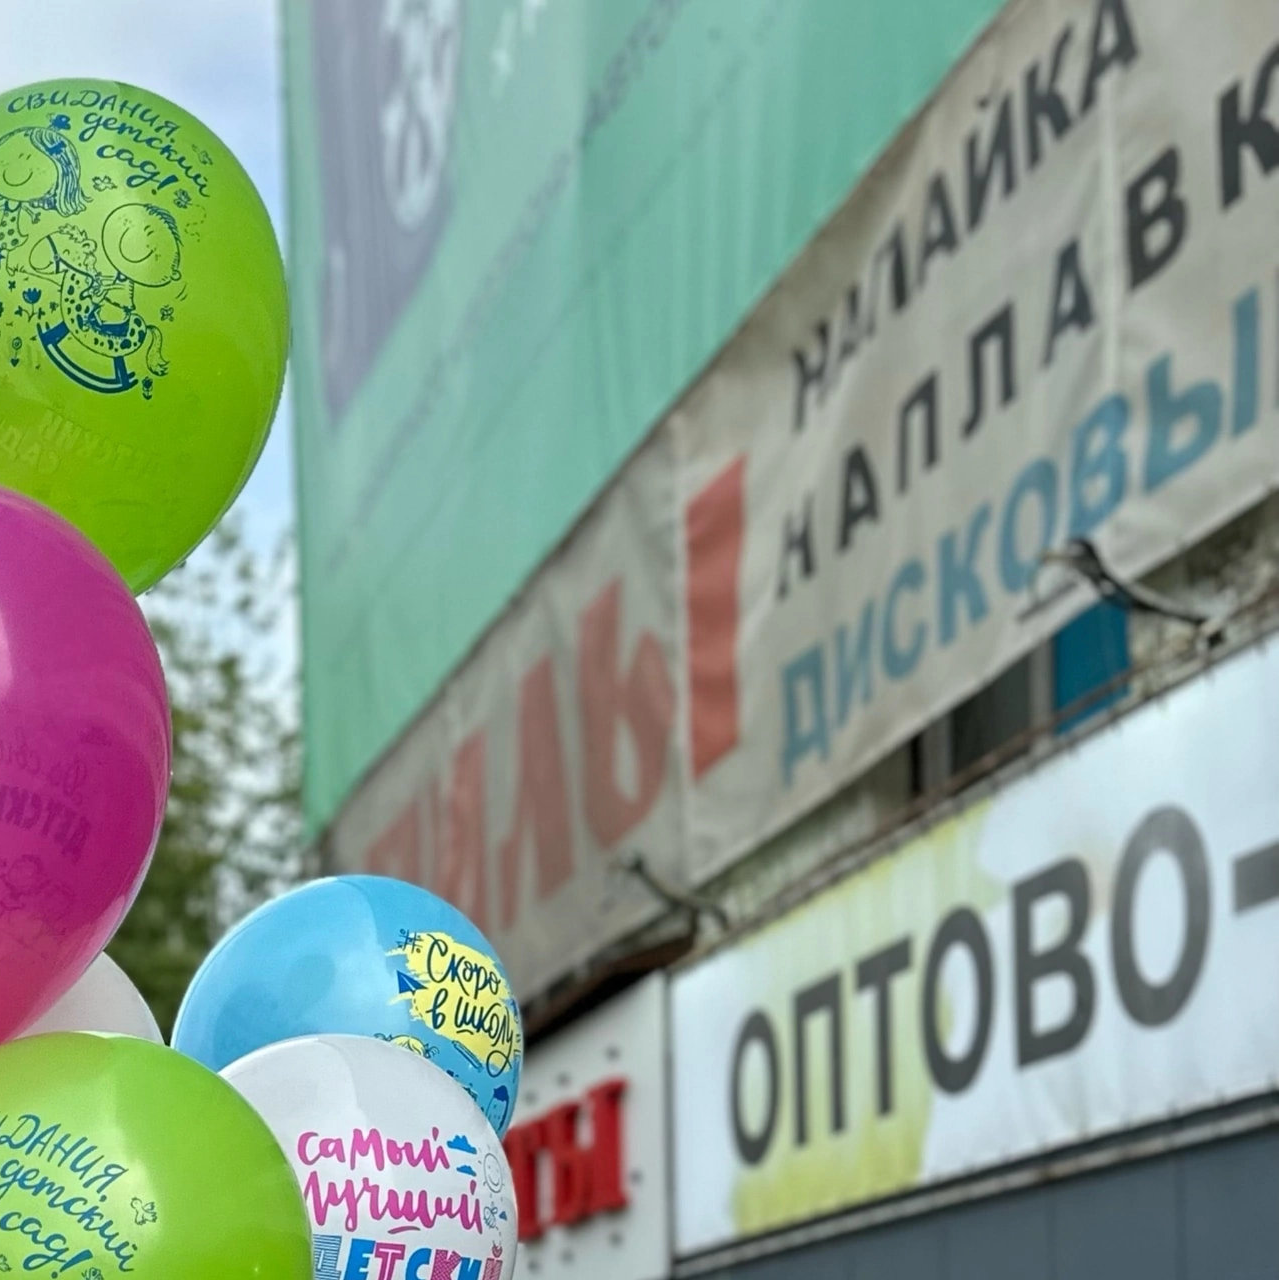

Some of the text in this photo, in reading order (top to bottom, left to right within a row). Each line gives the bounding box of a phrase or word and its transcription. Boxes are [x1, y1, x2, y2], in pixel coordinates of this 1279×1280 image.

[79, 112, 211, 198] детский
[96, 142, 179, 195] сад!
[781, 265, 1279, 788] ДИСКОВЫ
[427, 933, 501, 999] Скоро
[729, 802, 1279, 1170] ОПТОВО-
[425, 988, 514, 1077] в школу
